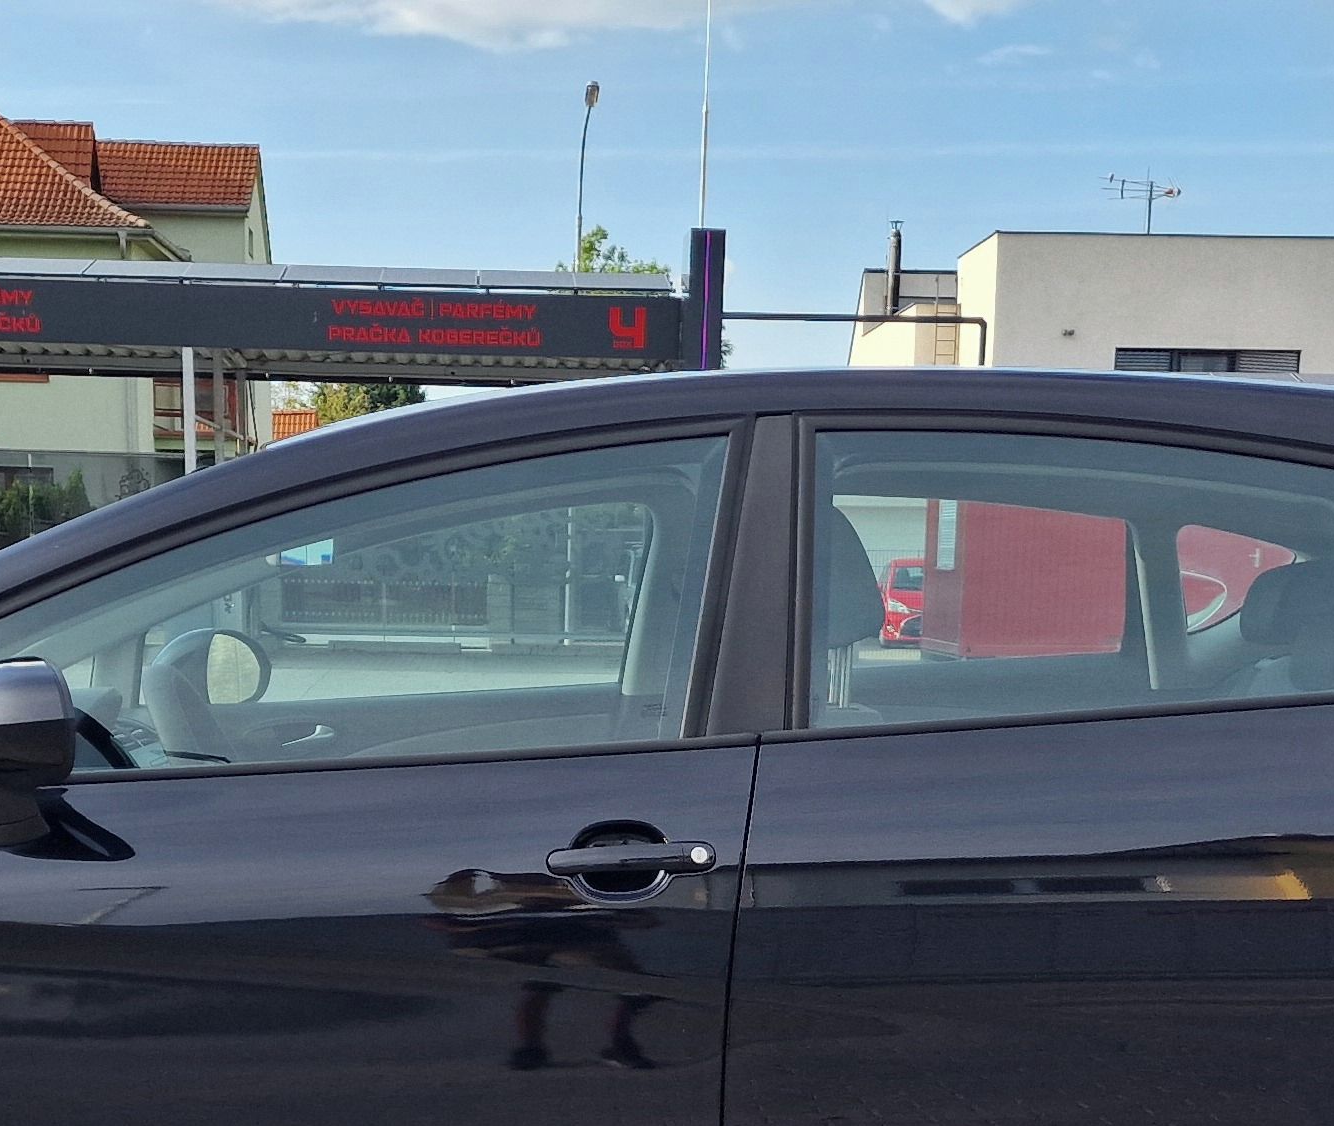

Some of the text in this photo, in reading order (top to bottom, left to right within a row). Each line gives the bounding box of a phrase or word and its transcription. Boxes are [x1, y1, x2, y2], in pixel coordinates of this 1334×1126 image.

[330, 297, 538, 320] VYSAVAČ PARFÉMY
[327, 322, 543, 348] PRAČKA KOBEREČKŮ
[608, 306, 647, 349] 4
